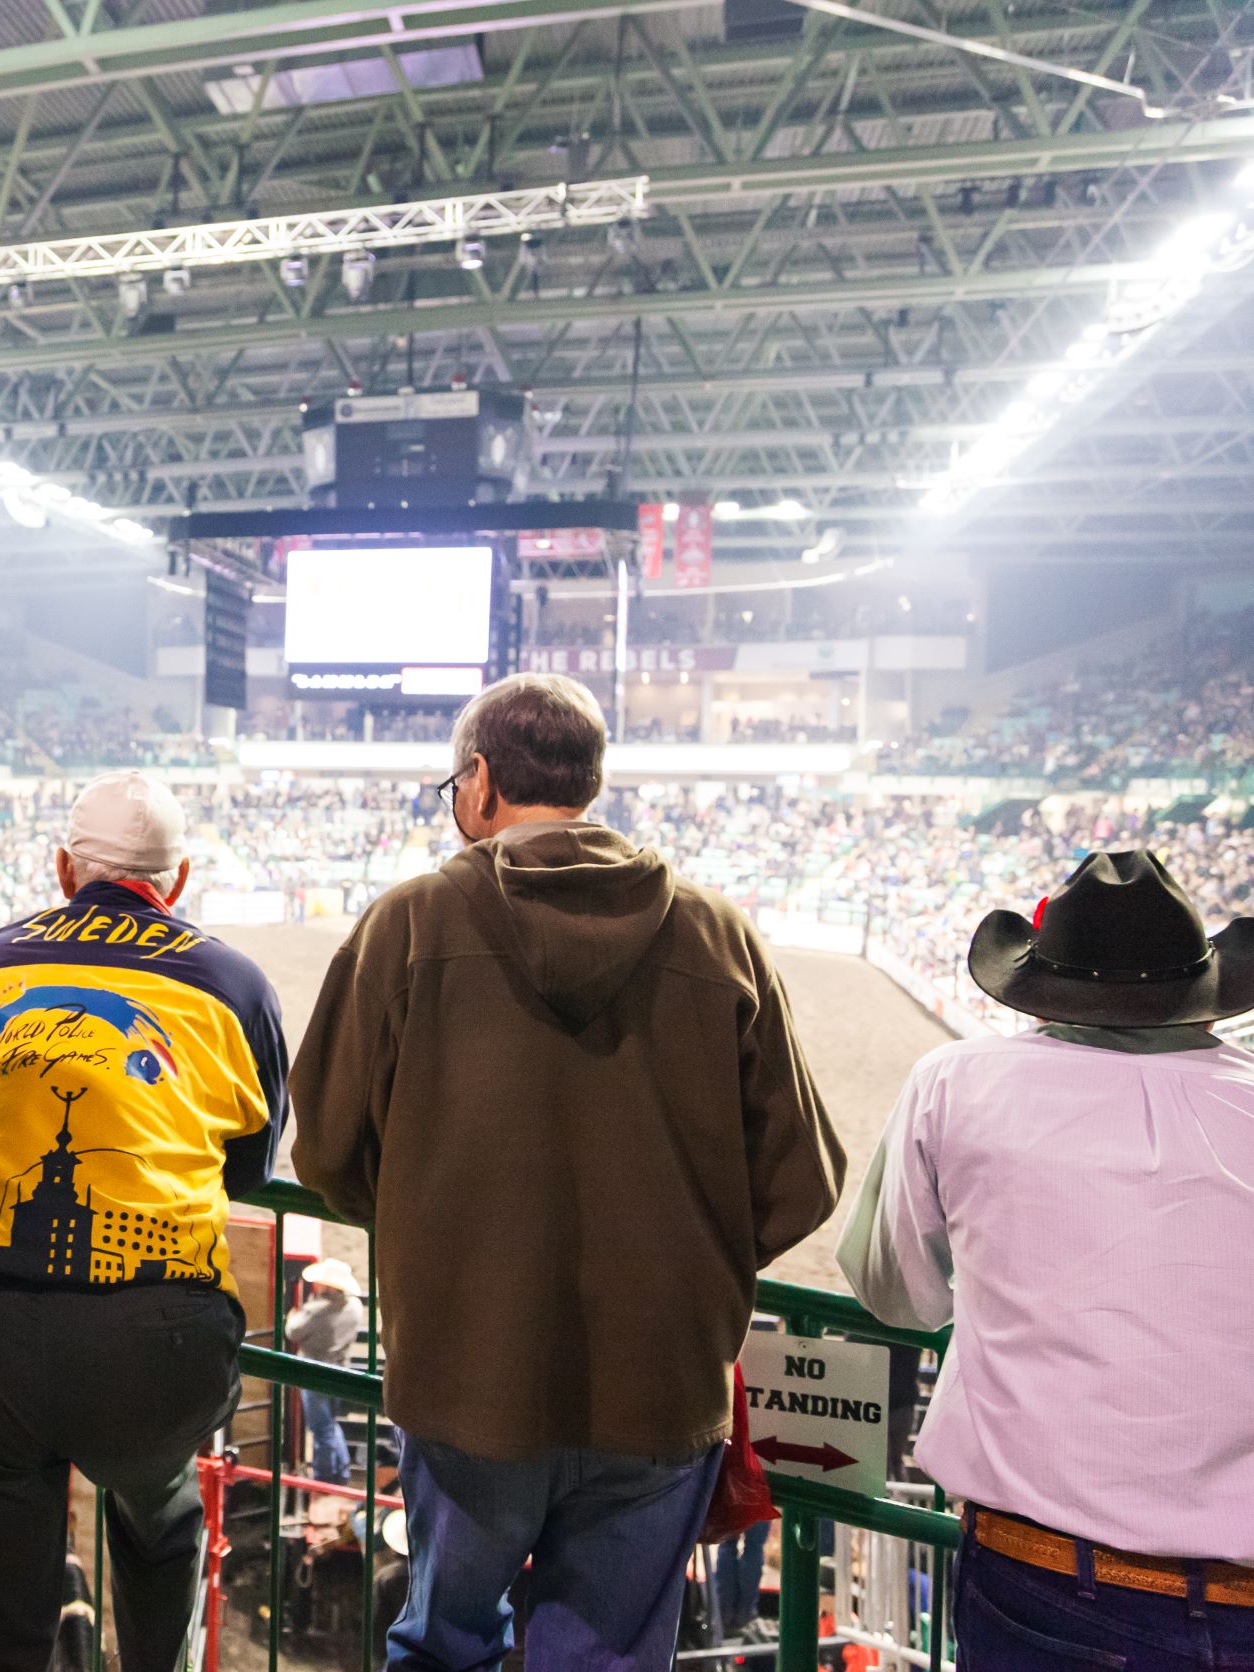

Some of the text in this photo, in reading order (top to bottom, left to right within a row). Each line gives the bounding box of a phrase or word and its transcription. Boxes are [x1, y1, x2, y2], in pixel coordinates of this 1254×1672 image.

[11, 905, 206, 959] SWEDEN
[785, 1355, 826, 1380] NO
[745, 1386, 882, 1424] TANDING
